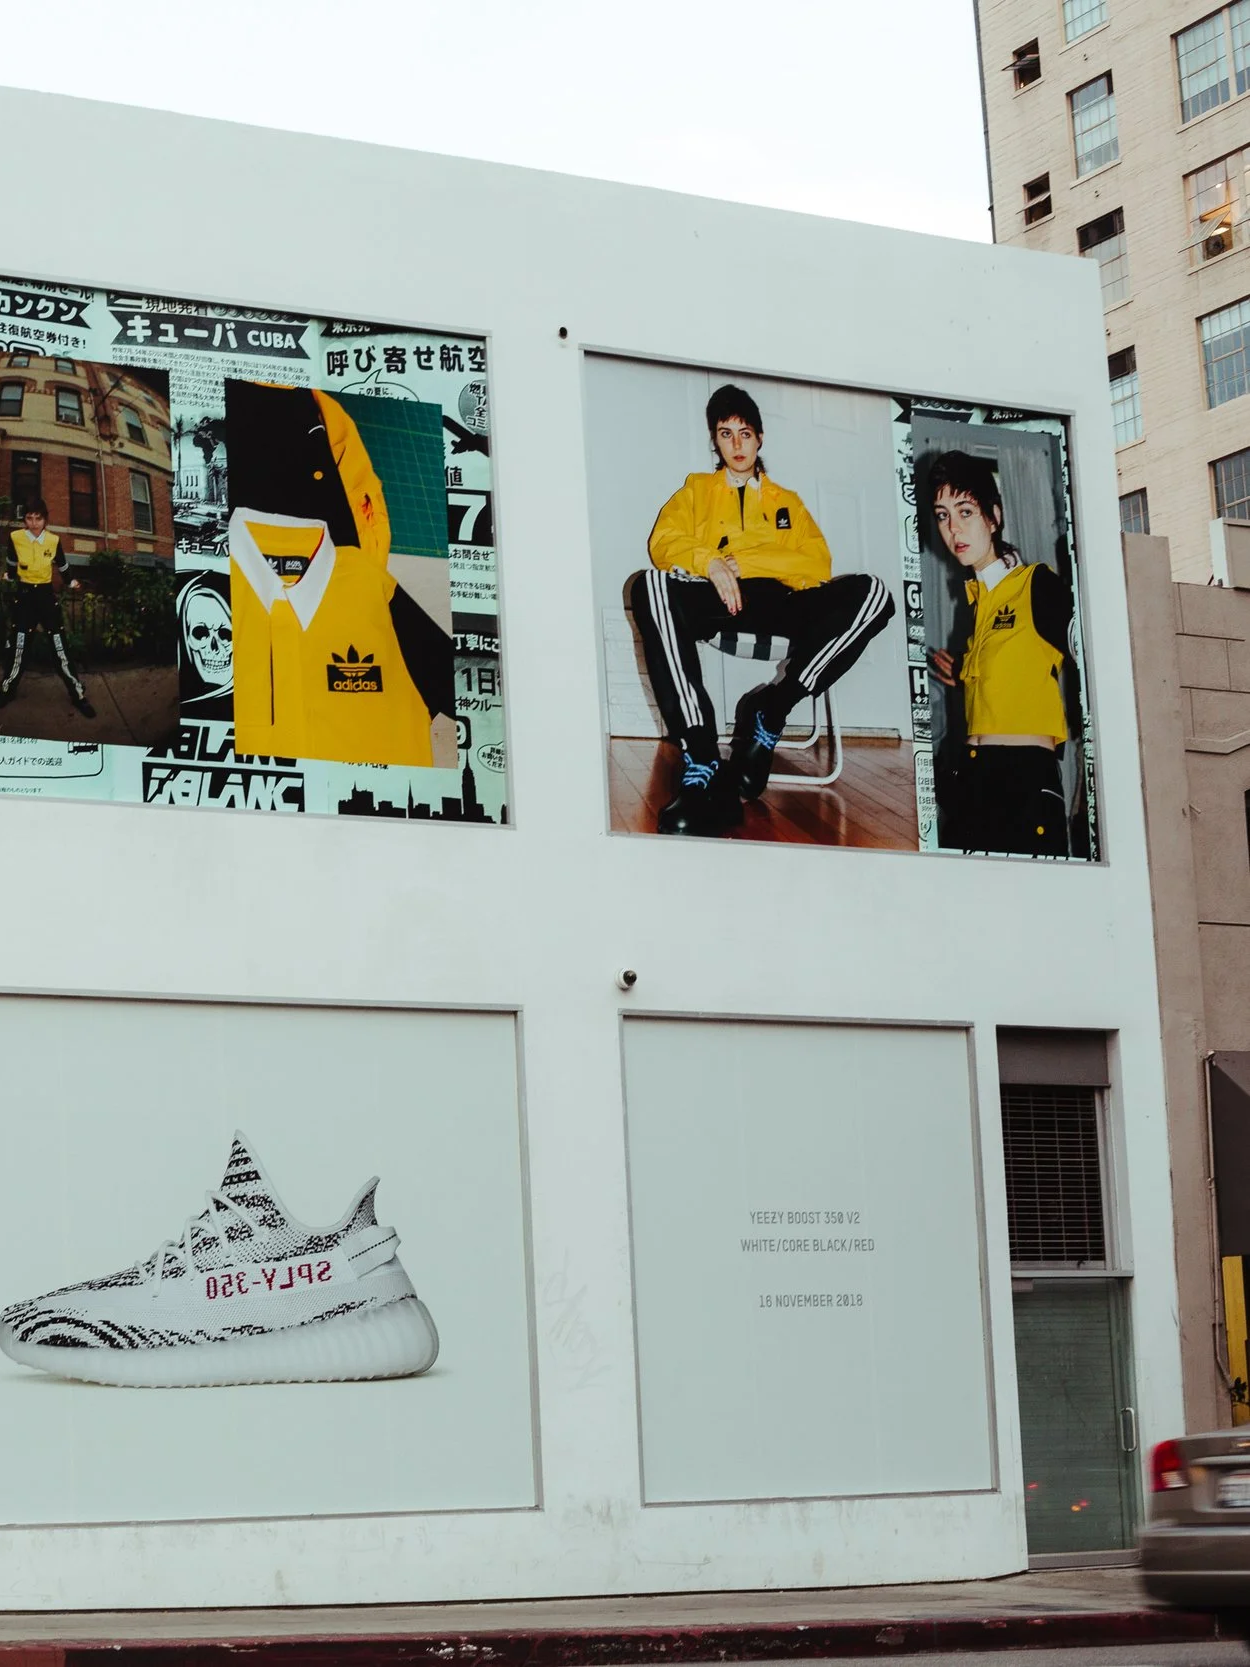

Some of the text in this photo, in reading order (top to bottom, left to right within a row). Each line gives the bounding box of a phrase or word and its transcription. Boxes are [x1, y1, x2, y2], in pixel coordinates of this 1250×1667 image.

[127, 314, 298, 350] キューバ CUBA
[448, 493, 487, 542] 7
[907, 584, 923, 609] G
[333, 678, 378, 692] adidas
[454, 696, 502, 712] 神クルー
[750, 1211, 861, 1224] YEEZY BOOST 350 V2
[740, 1238, 875, 1252] WHITE/CORE BLACK/RED
[775, 1294, 833, 1308] NOVEMBER
[836, 1294, 863, 1307] 2018
